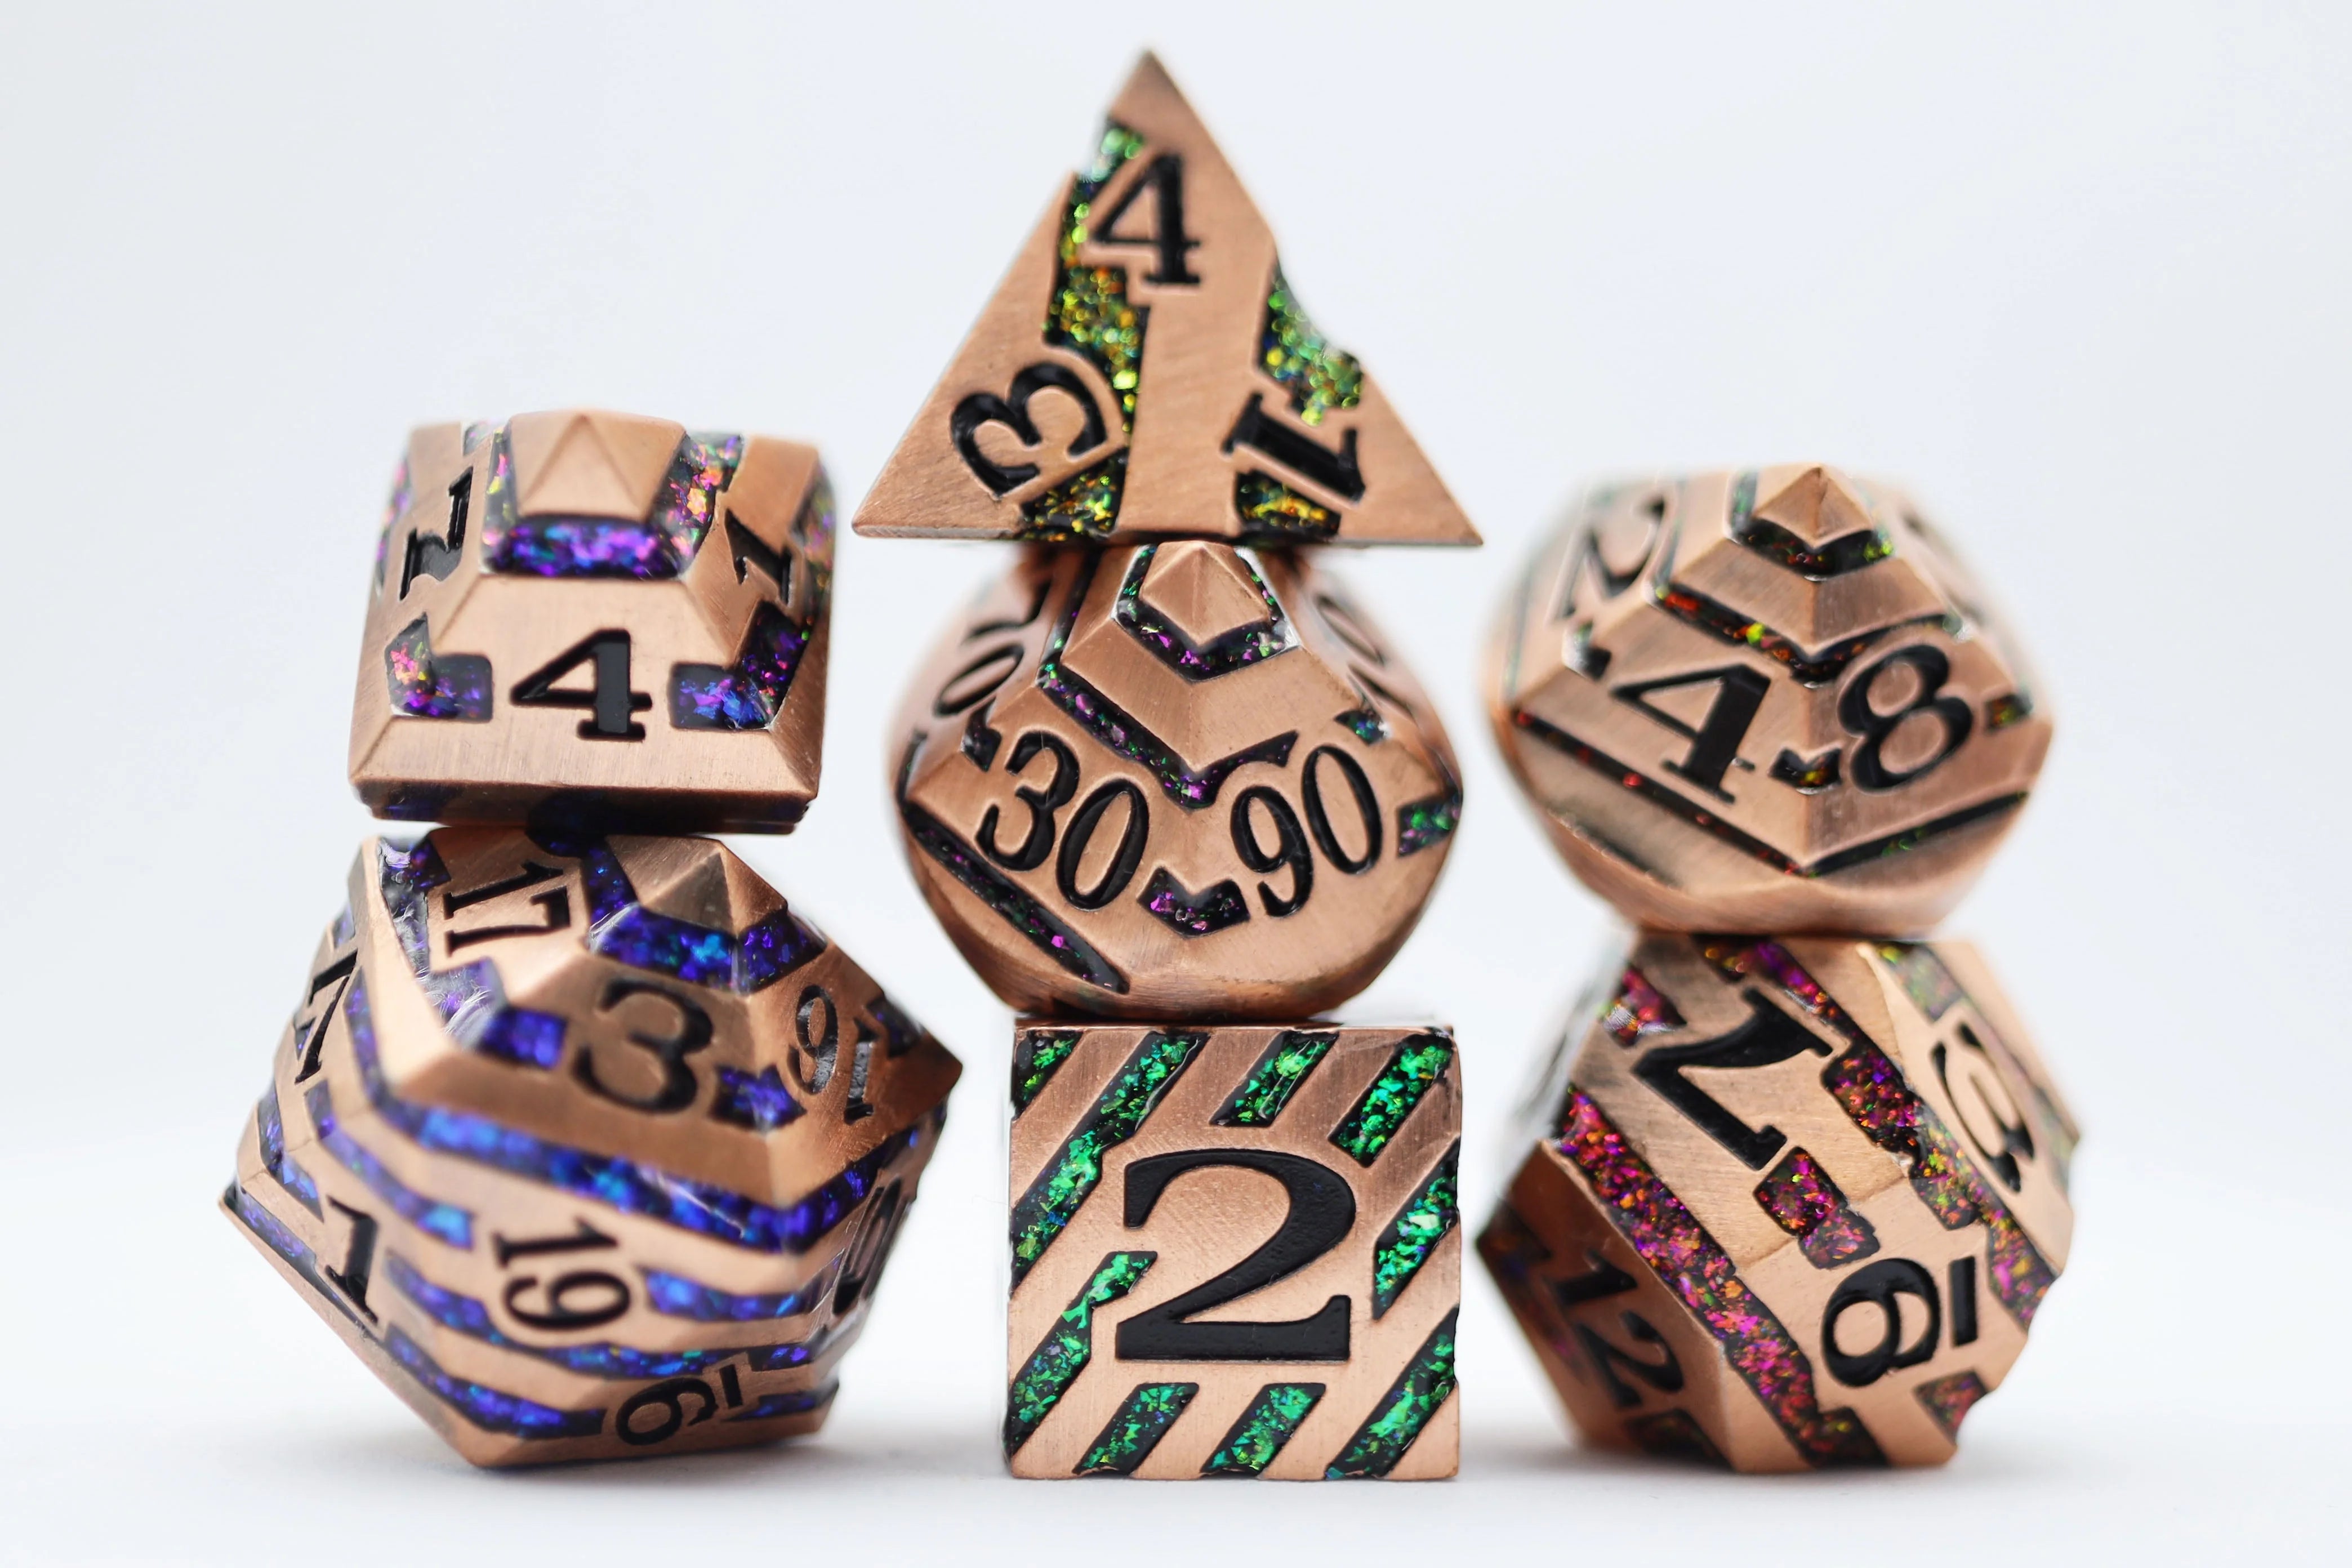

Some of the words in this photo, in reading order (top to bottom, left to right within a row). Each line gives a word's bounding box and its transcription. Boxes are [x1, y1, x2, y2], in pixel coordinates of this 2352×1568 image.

[1090, 152, 1201, 286] 4
[948, 362, 1109, 500] 3
[1221, 392, 1367, 504] 1
[510, 627, 653, 742] 4
[1610, 663, 1773, 804] 4
[1839, 644, 1975, 793] 8
[974, 730, 1150, 912] 30
[1229, 743, 1383, 919] 90
[443, 860, 571, 957] 17
[572, 978, 714, 1115] 3
[1630, 986, 1833, 1171] 7
[324, 1193, 378, 1325] 1
[490, 1215, 631, 1331] 19
[1115, 1147, 1357, 1362] 2
[1542, 1246, 1685, 1411] 12
